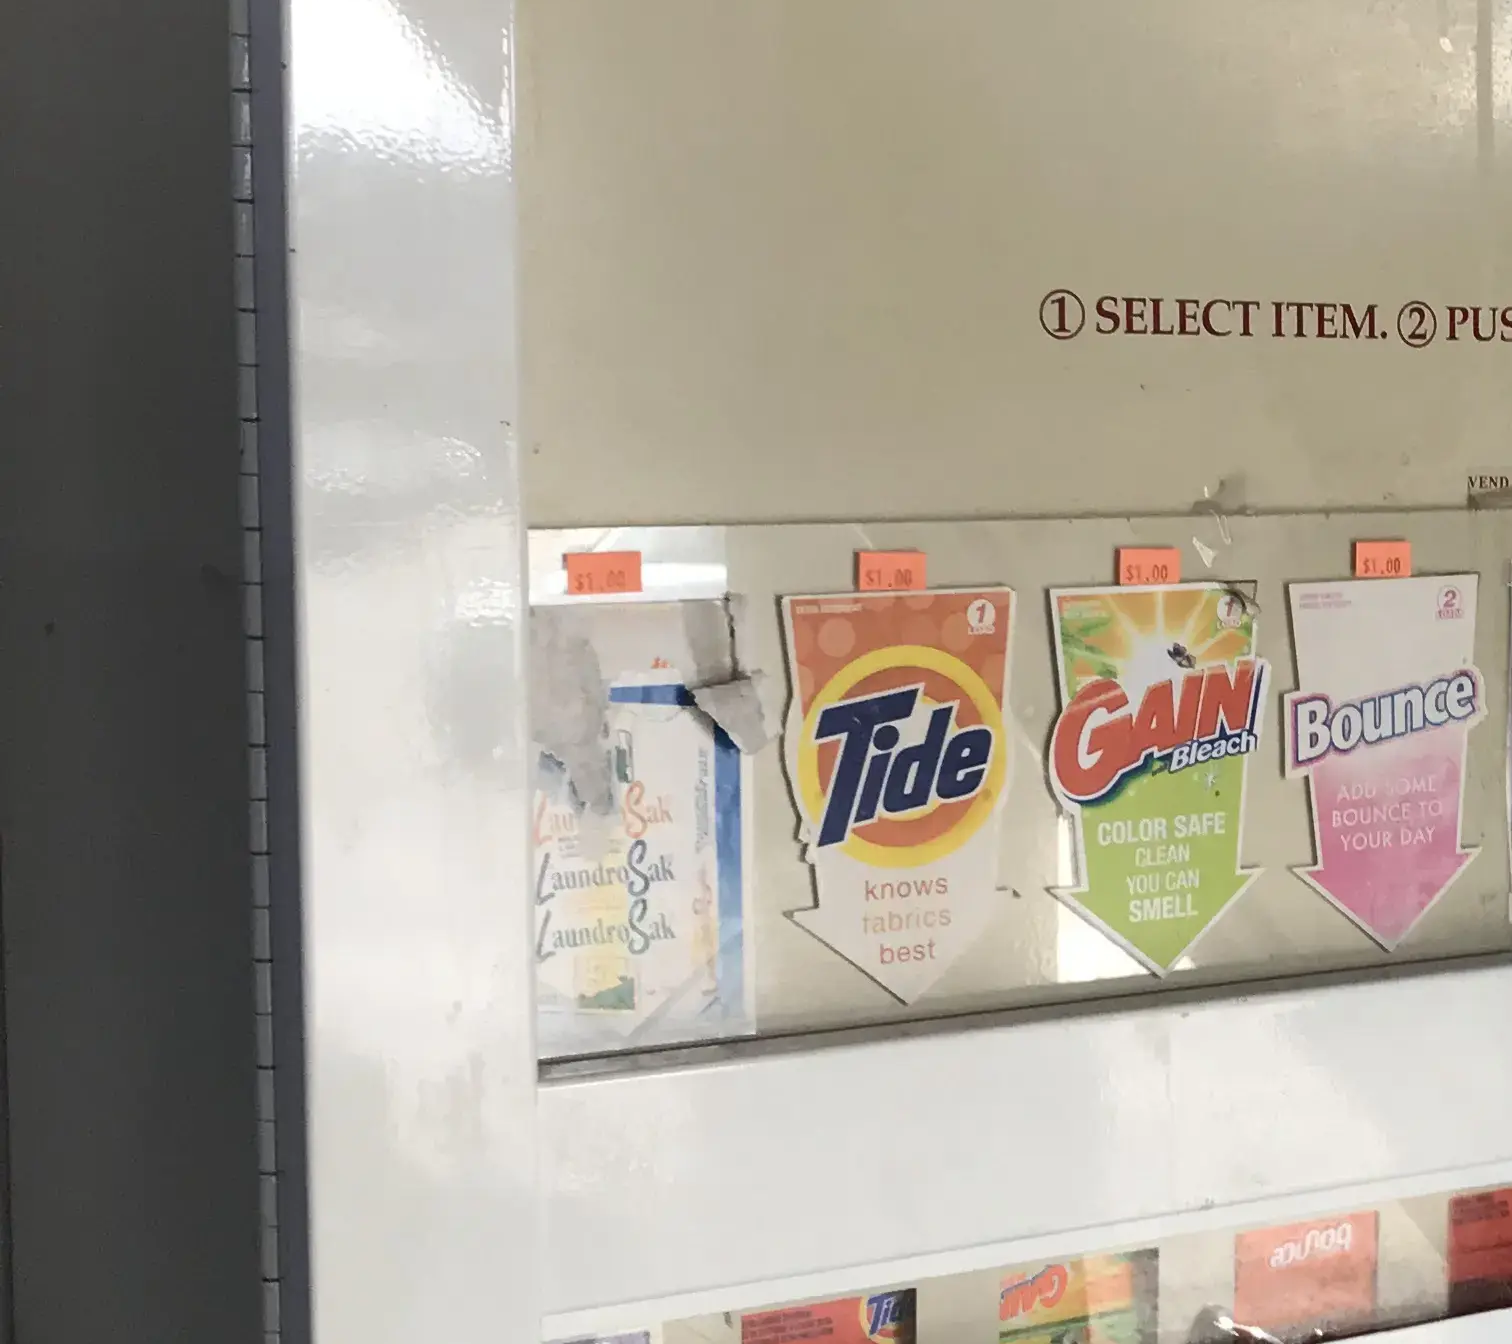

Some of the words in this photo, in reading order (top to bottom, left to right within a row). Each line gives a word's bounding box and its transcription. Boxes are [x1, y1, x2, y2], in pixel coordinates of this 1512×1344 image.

[1096, 295, 1261, 337] SELECT
[1271, 300, 1389, 340] ITEM.
[1468, 475, 1509, 489] VEND
[865, 569, 913, 588] $1.00
[1125, 564, 1168, 583] $1.00
[1363, 557, 1401, 575] $1.00
[575, 569, 626, 593] $1.00
[1443, 590, 1457, 608] 2
[1053, 659, 1260, 798] GAIN
[1297, 673, 1475, 765] Bounce
[814, 683, 992, 849] Tide
[1168, 733, 1258, 774] Bleach
[1337, 783, 1376, 804] ADD
[1332, 802, 1411, 828] BOUNCE
[1420, 799, 1443, 818] TO
[1098, 816, 1169, 845] COLOR
[1174, 812, 1226, 836] SAFE
[1340, 831, 1393, 852] YOUR
[1400, 826, 1436, 846] DAY
[1134, 846, 1191, 867] CLEAN
[864, 875, 949, 902] knows
[1125, 874, 1161, 895] YOU
[1165, 869, 1200, 890] CAN
[862, 906, 953, 936] fabrics
[1128, 896, 1200, 923] SMELL
[879, 939, 936, 966] best
[1269, 1222, 1353, 1269] bounce
